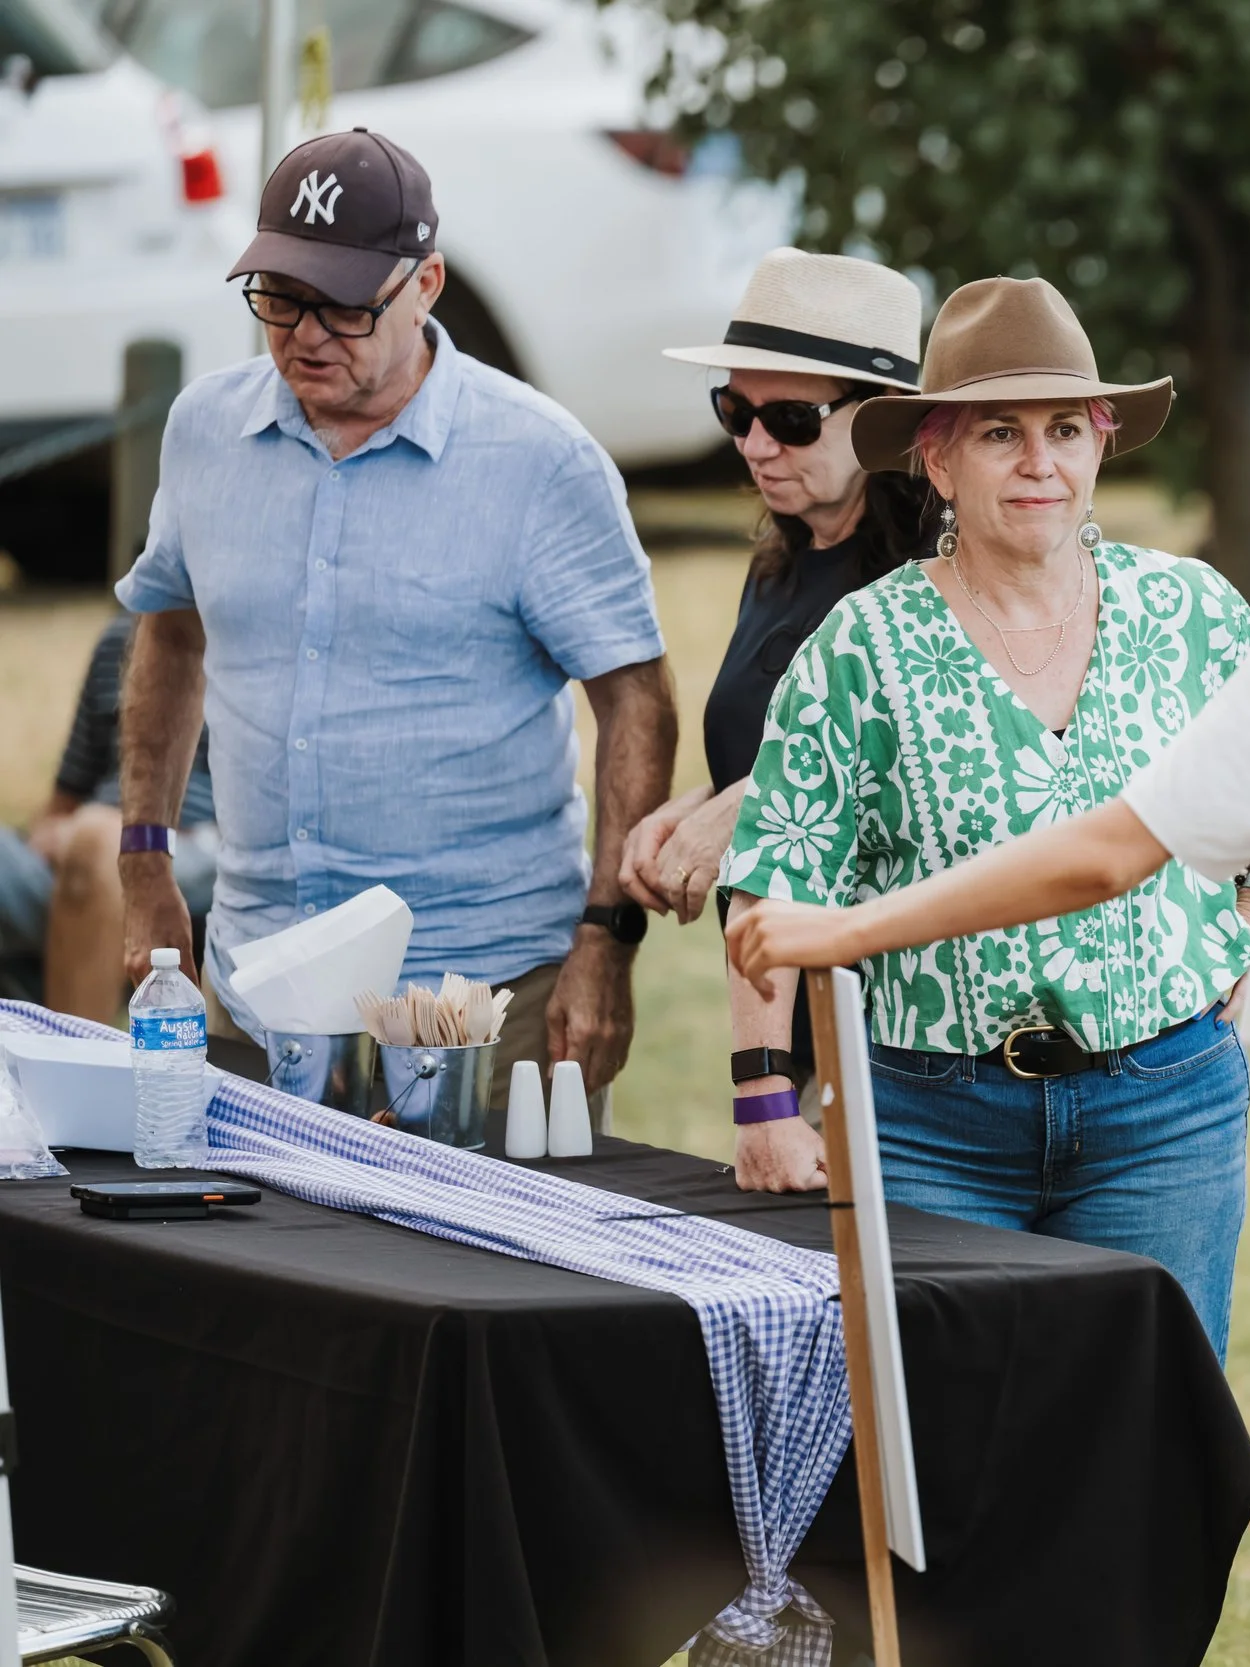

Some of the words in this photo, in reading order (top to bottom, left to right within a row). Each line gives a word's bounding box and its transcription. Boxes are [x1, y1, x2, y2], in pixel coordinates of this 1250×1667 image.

[289, 169, 344, 226] NY
[160, 1019, 199, 1033] Aussie
[160, 1040, 182, 1048] Spring
